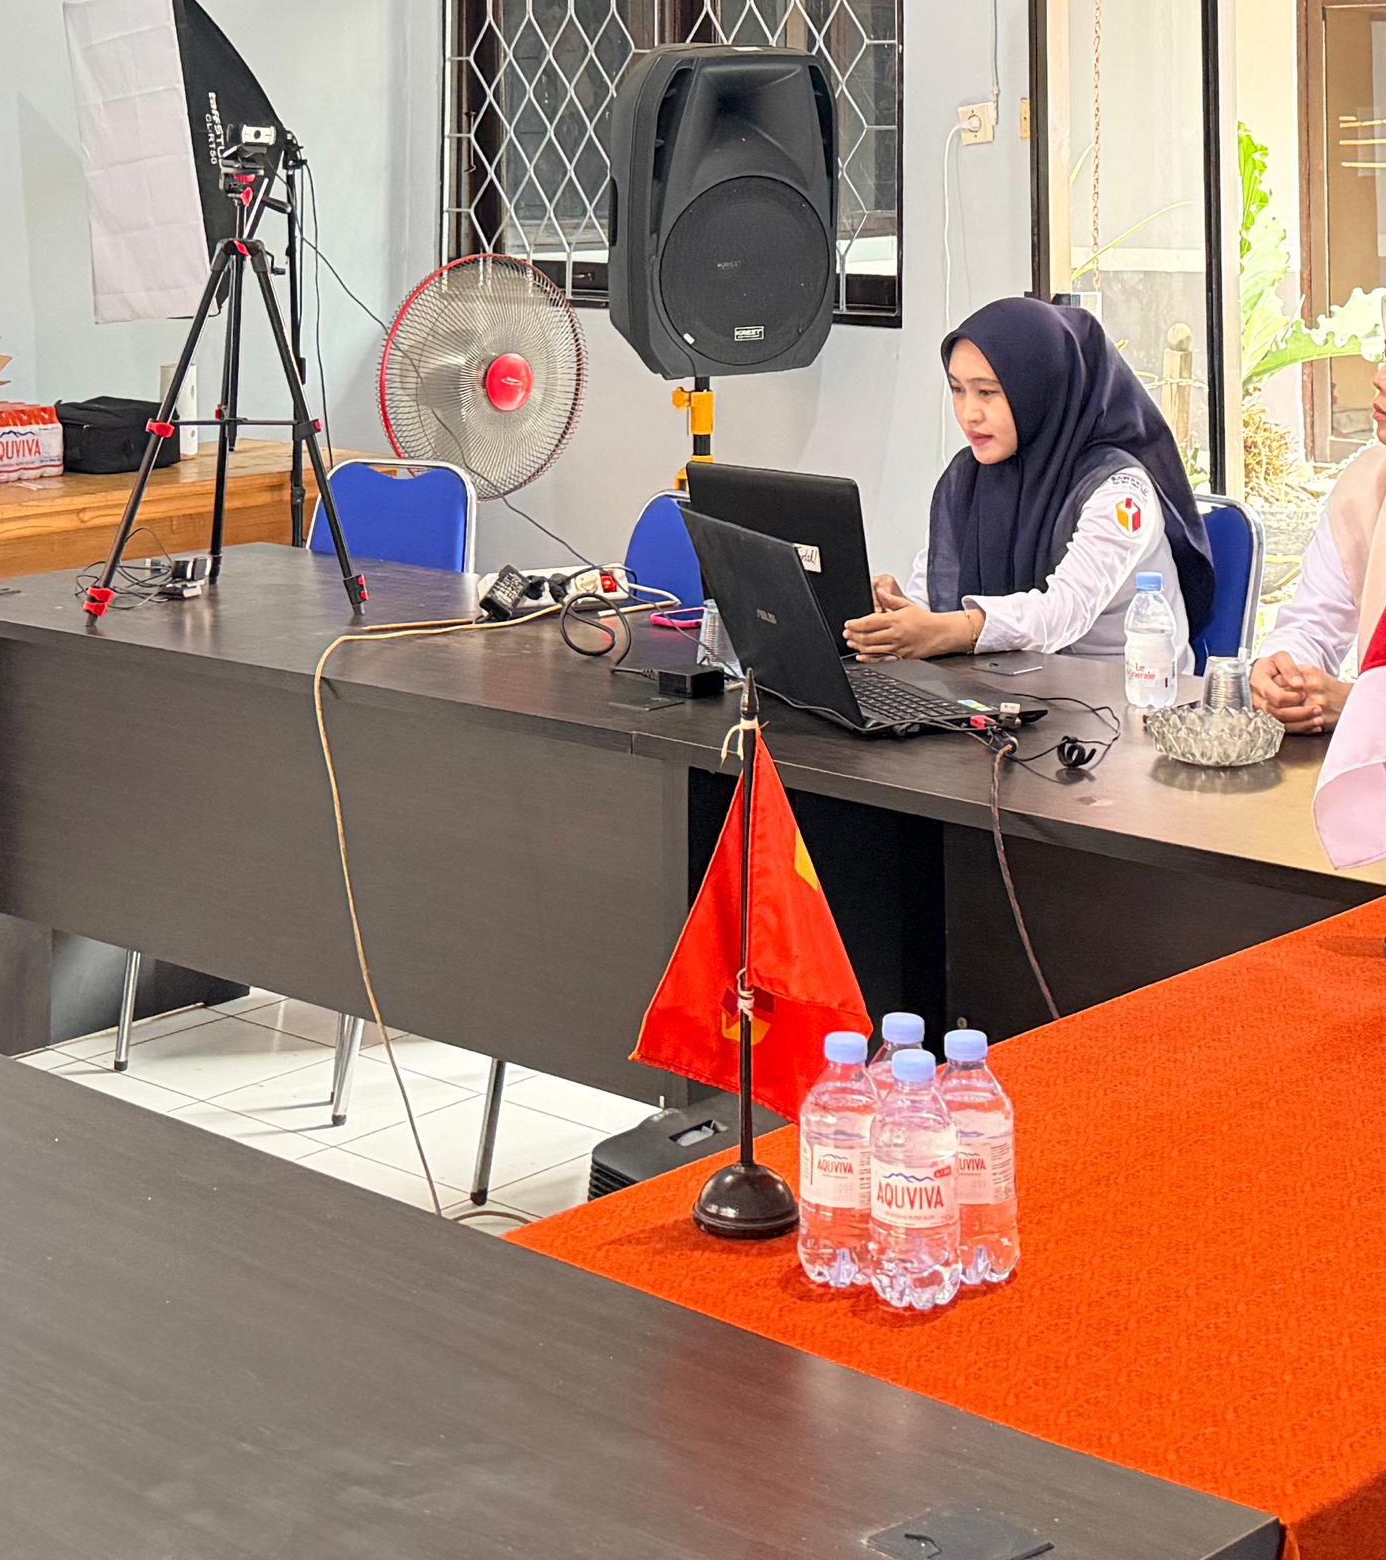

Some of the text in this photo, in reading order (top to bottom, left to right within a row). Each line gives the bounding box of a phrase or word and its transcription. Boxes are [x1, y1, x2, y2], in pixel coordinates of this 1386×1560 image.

[817, 1157, 854, 1175] AQUVIVA
[959, 1157, 987, 1170] UVIVA
[876, 1179, 944, 1210] AQUVIVA
